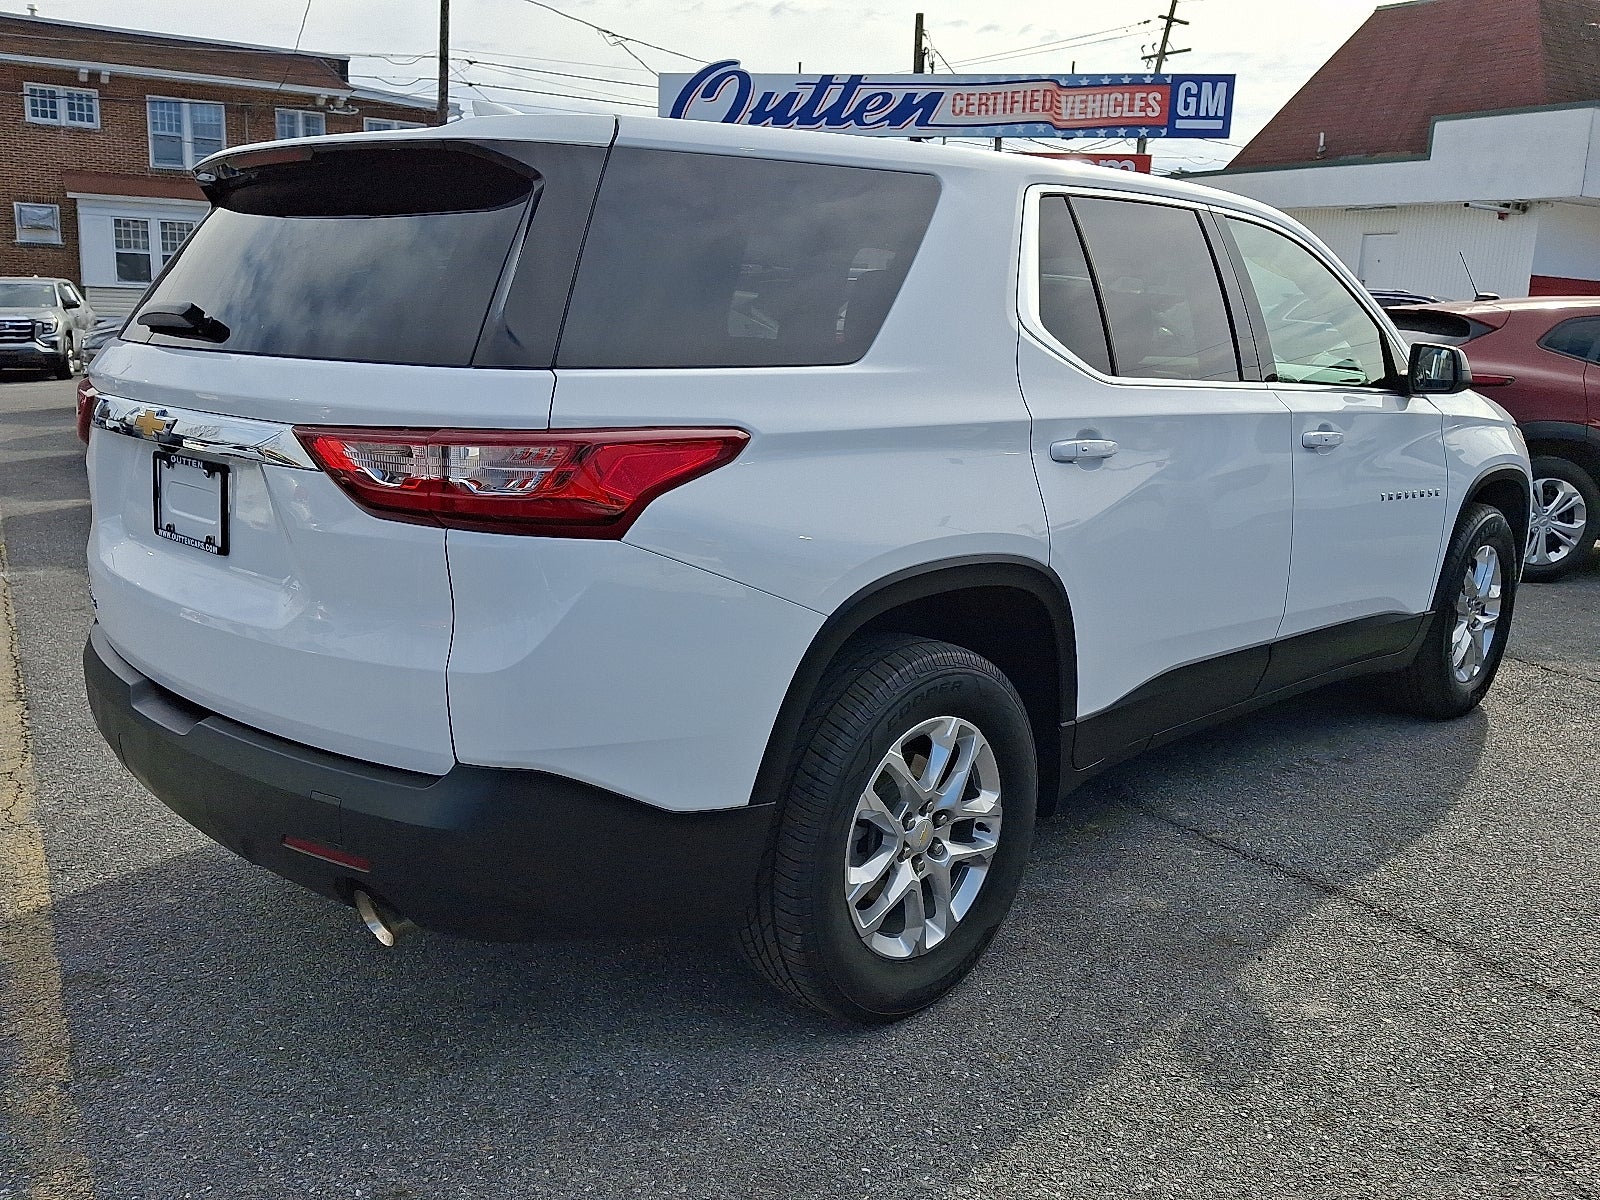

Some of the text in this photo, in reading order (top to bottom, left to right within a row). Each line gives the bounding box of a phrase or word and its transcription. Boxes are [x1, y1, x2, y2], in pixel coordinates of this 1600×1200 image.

[668, 59, 1162, 128] Outten CERTIFIED VEHICLES
[1175, 81, 1228, 118] GM
[170, 455, 204, 469] OUTTEN
[1380, 487, 1441, 502] TRAVERSE
